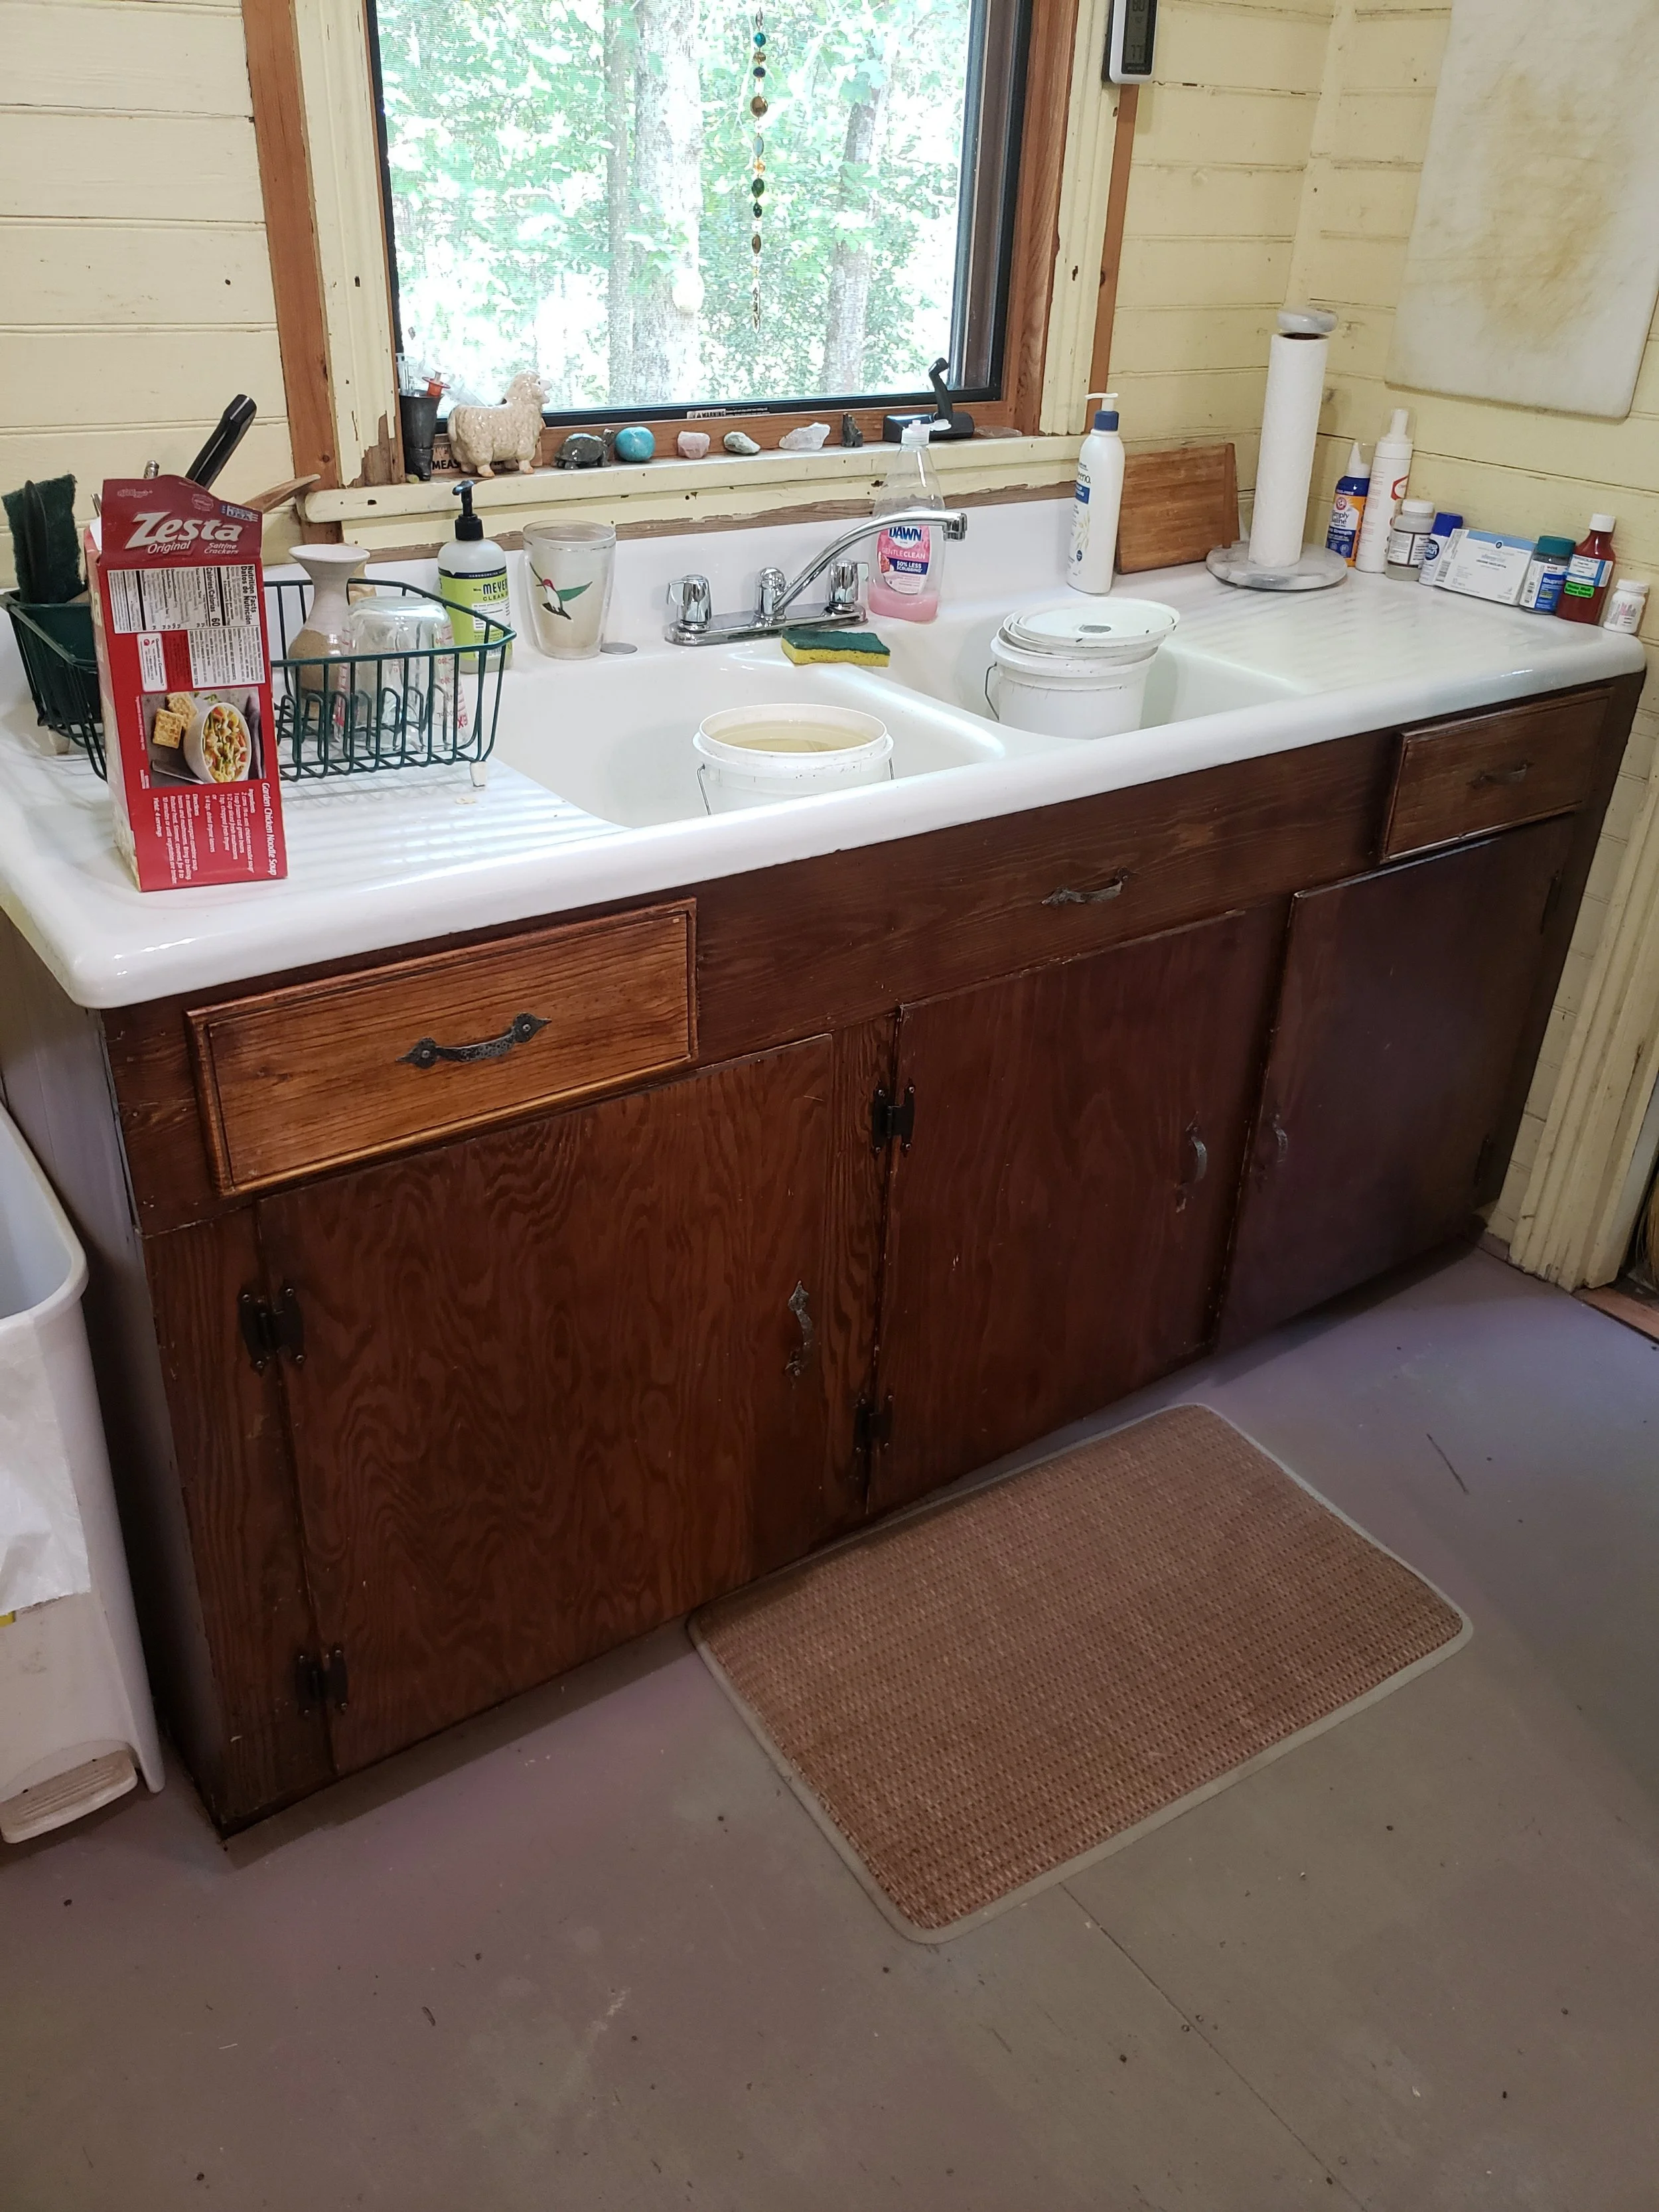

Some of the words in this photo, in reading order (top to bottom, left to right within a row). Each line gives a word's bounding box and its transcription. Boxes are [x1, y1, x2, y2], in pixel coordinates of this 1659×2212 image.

[125, 511, 244, 550] Zesta
[889, 526, 922, 542] DAWN
[147, 540, 190, 554] Original
[882, 548, 903, 557] GENTLE
[244, 596, 252, 625] Nutrición
[212, 618, 220, 627] 60
[262, 783, 271, 806] Garden
[264, 808, 273, 833] Chicken
[267, 834, 276, 857] Noodle
[267, 859, 277, 875] Soup
